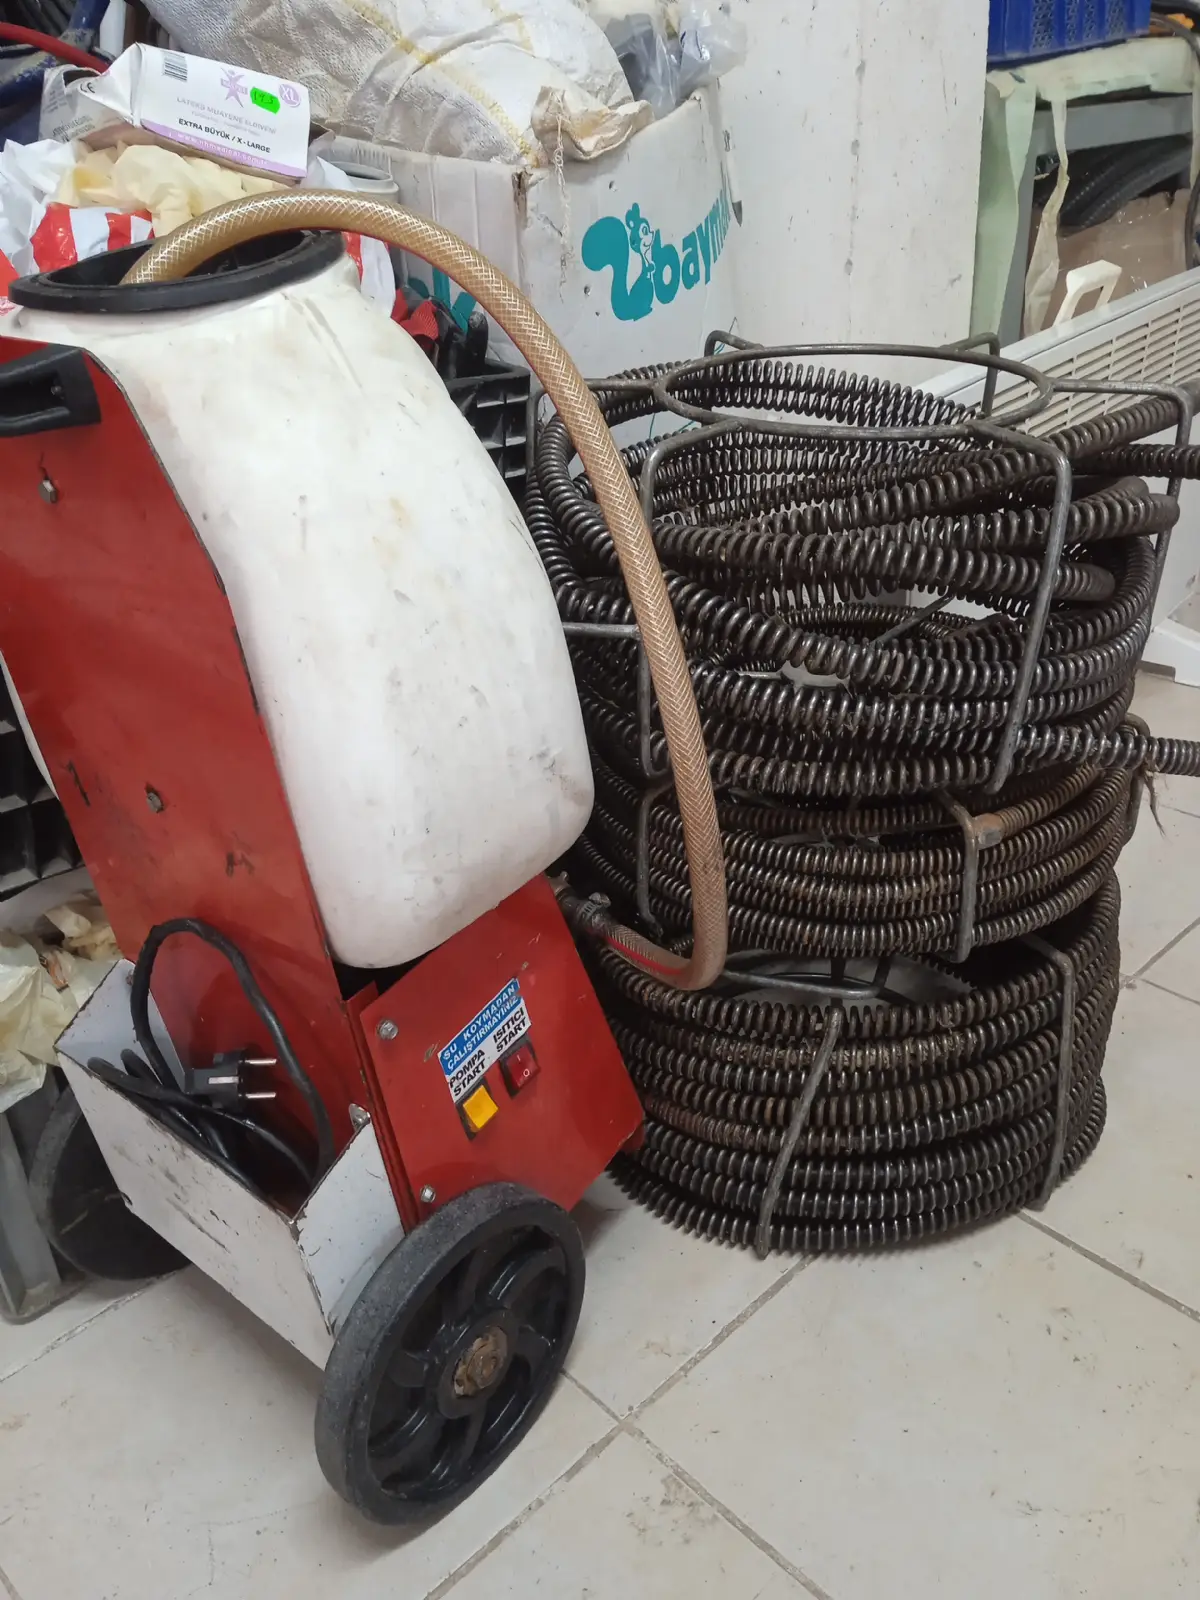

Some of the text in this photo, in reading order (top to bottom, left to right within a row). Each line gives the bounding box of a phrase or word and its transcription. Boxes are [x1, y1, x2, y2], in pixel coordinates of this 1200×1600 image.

[280, 85, 299, 105] XL
[179, 118, 203, 131] EXTRA
[205, 126, 230, 140] BÜYÜK
[443, 985, 515, 1060] SU KOYMADAN
[496, 1017, 527, 1053] START
[449, 1049, 485, 1088] POMPA
[453, 1059, 486, 1096] START
